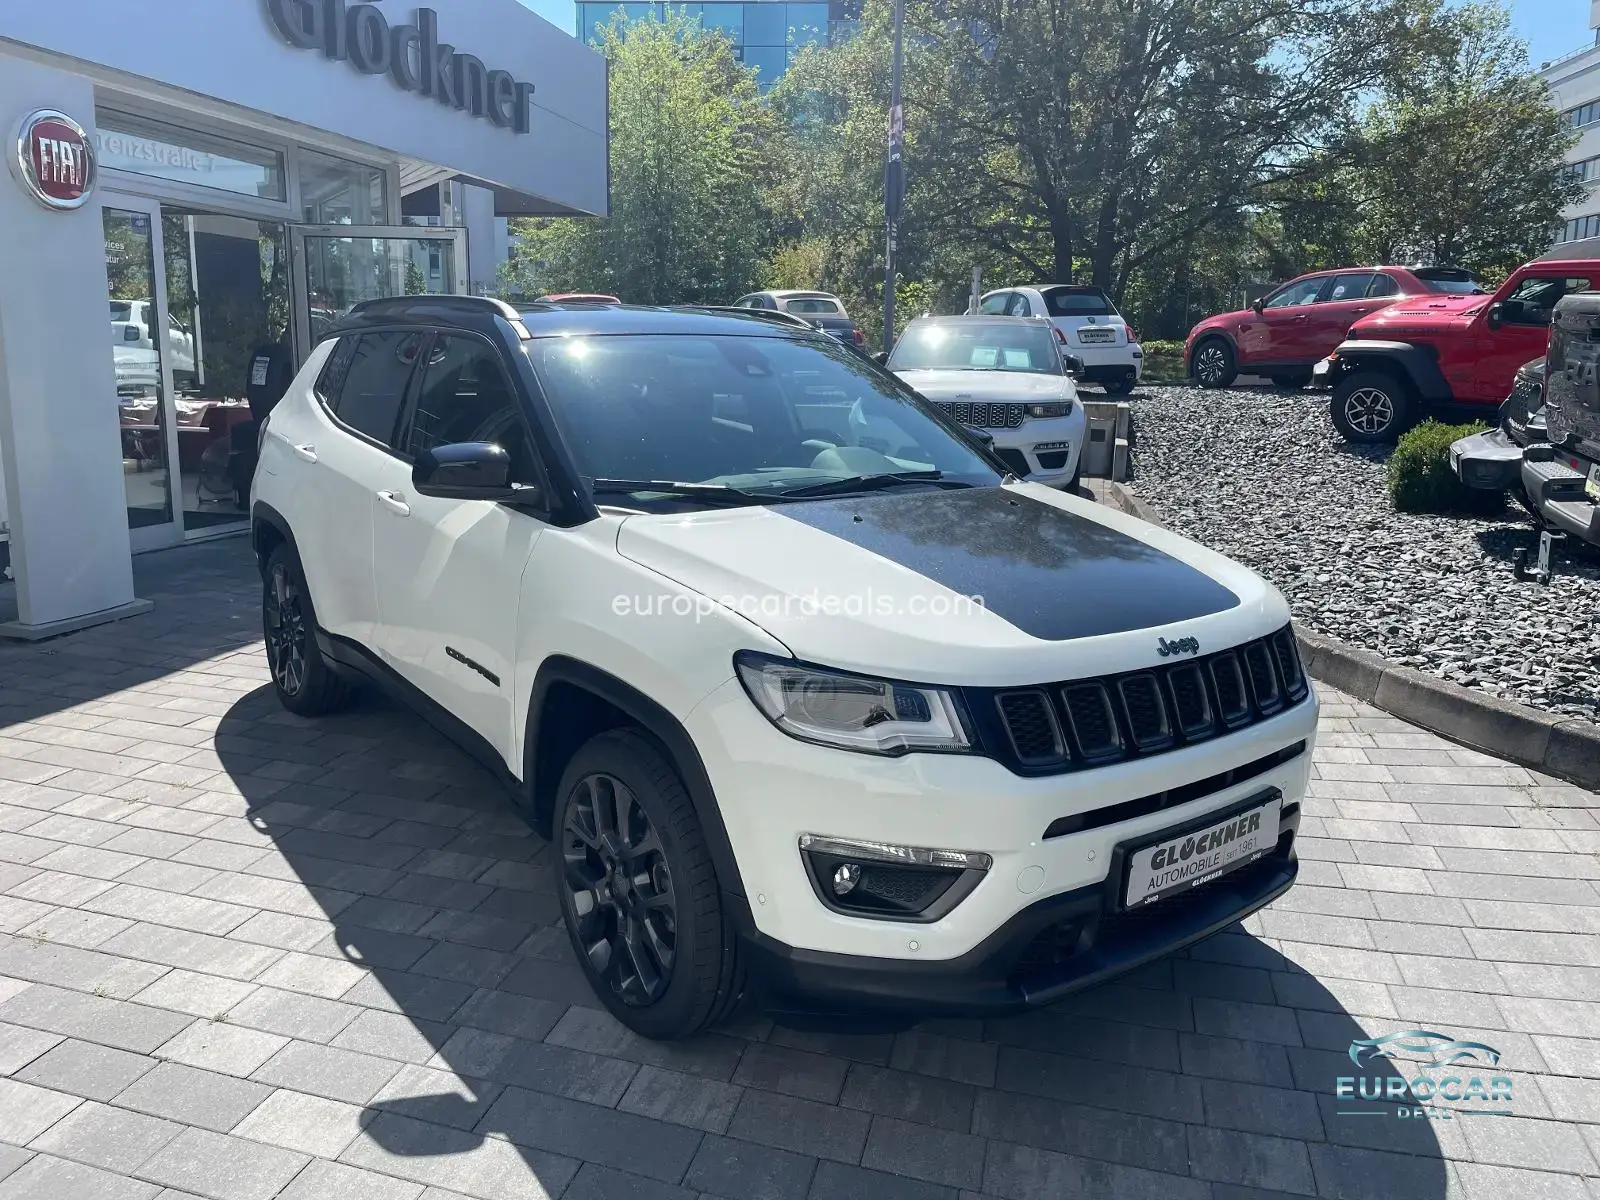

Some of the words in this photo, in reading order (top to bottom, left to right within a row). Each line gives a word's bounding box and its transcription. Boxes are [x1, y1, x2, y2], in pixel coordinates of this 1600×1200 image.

[38, 136, 83, 186] FIAT
[1157, 636, 1200, 657] Jeep
[1147, 852, 1220, 891] AUTOMOBILE
[1239, 837, 1257, 854] 1961
[1144, 894, 1159, 904] Jeep
